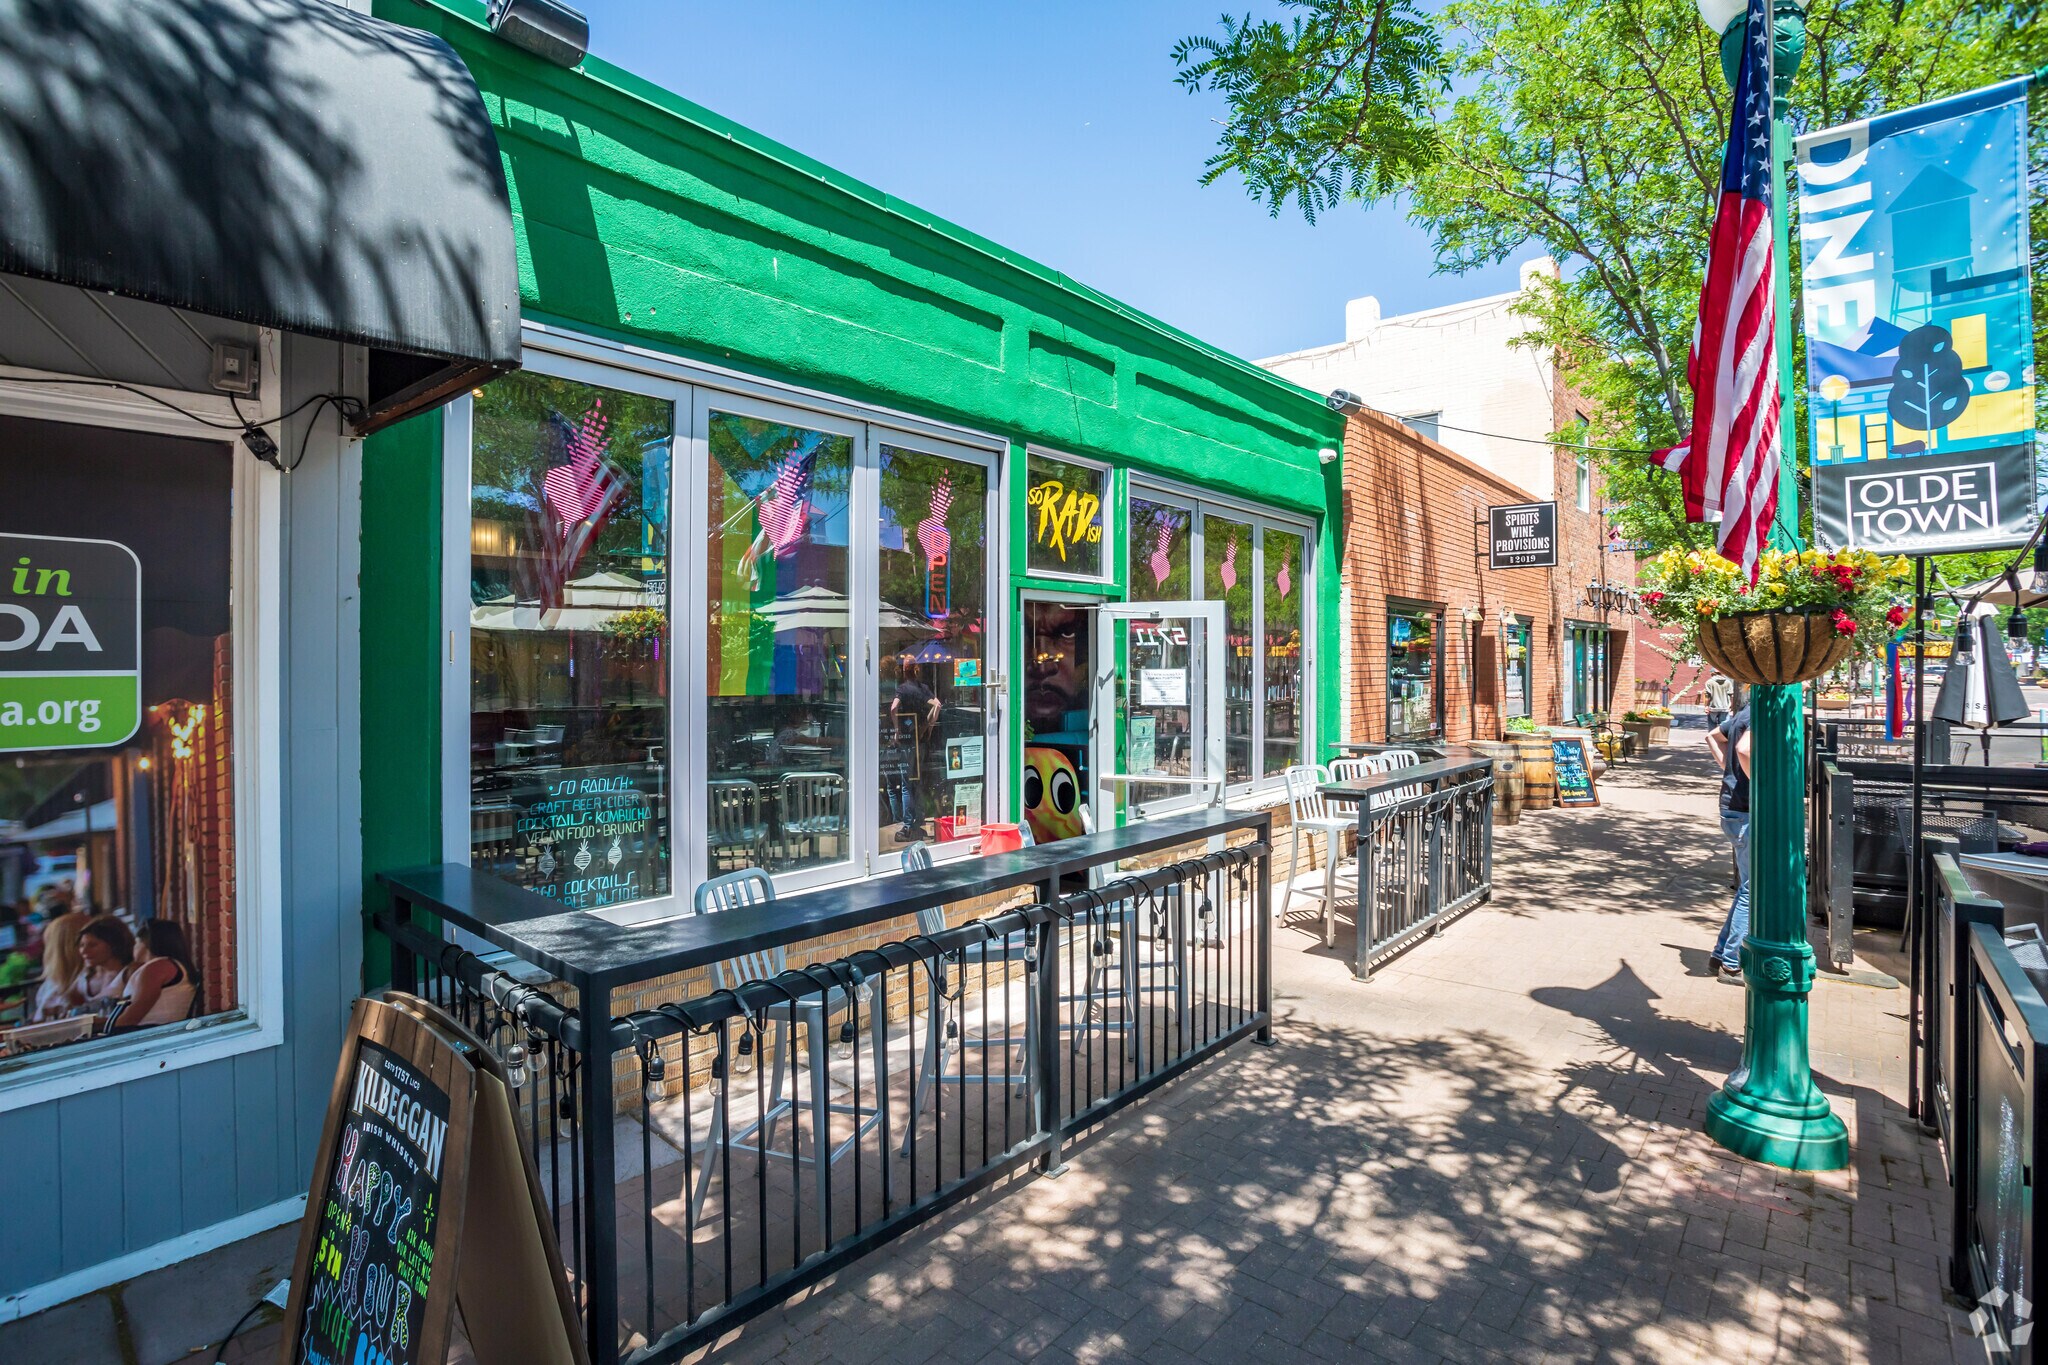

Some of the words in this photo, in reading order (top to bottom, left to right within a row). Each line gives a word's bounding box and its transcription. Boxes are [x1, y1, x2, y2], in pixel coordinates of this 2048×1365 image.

[1798, 120, 1876, 336] DINE
[1859, 470, 1979, 509] OLDE
[1027, 487, 1043, 505] SO
[1038, 480, 1099, 562] RAD
[1505, 512, 1540, 527] SPIRITS
[1510, 525, 1535, 539] WINE
[1853, 500, 1989, 538] TOWN
[1495, 536, 1550, 552] PROVISIONS
[1514, 554, 1536, 564] 2019
[12, 556, 73, 597] in
[930, 531, 947, 614] OPEN
[0, 699, 102, 733] a.org
[550, 780, 576, 796] SO
[580, 776, 629, 793] RADISH
[517, 811, 592, 832] COCKTAILS
[595, 806, 652, 824] KOMBUCHA
[530, 799, 572, 815] CRAFT
[572, 796, 602, 812] BEER
[607, 793, 640, 808] CIDER
[525, 828, 565, 844] VEGAN
[567, 825, 595, 840] FOOD
[603, 820, 645, 836] BRUNCH
[564, 870, 636, 894] COCKTAILS
[394, 1065, 411, 1085] 1757
[352, 1059, 448, 1184] KILBEGGAN
[363, 1121, 383, 1138] IRISH
[385, 1131, 419, 1176] WHISKEY
[336, 1123, 412, 1245] HAPPY
[327, 1200, 347, 1231] OPEN
[326, 1244, 342, 1281] PM
[342, 1224, 412, 1350] HOUR
